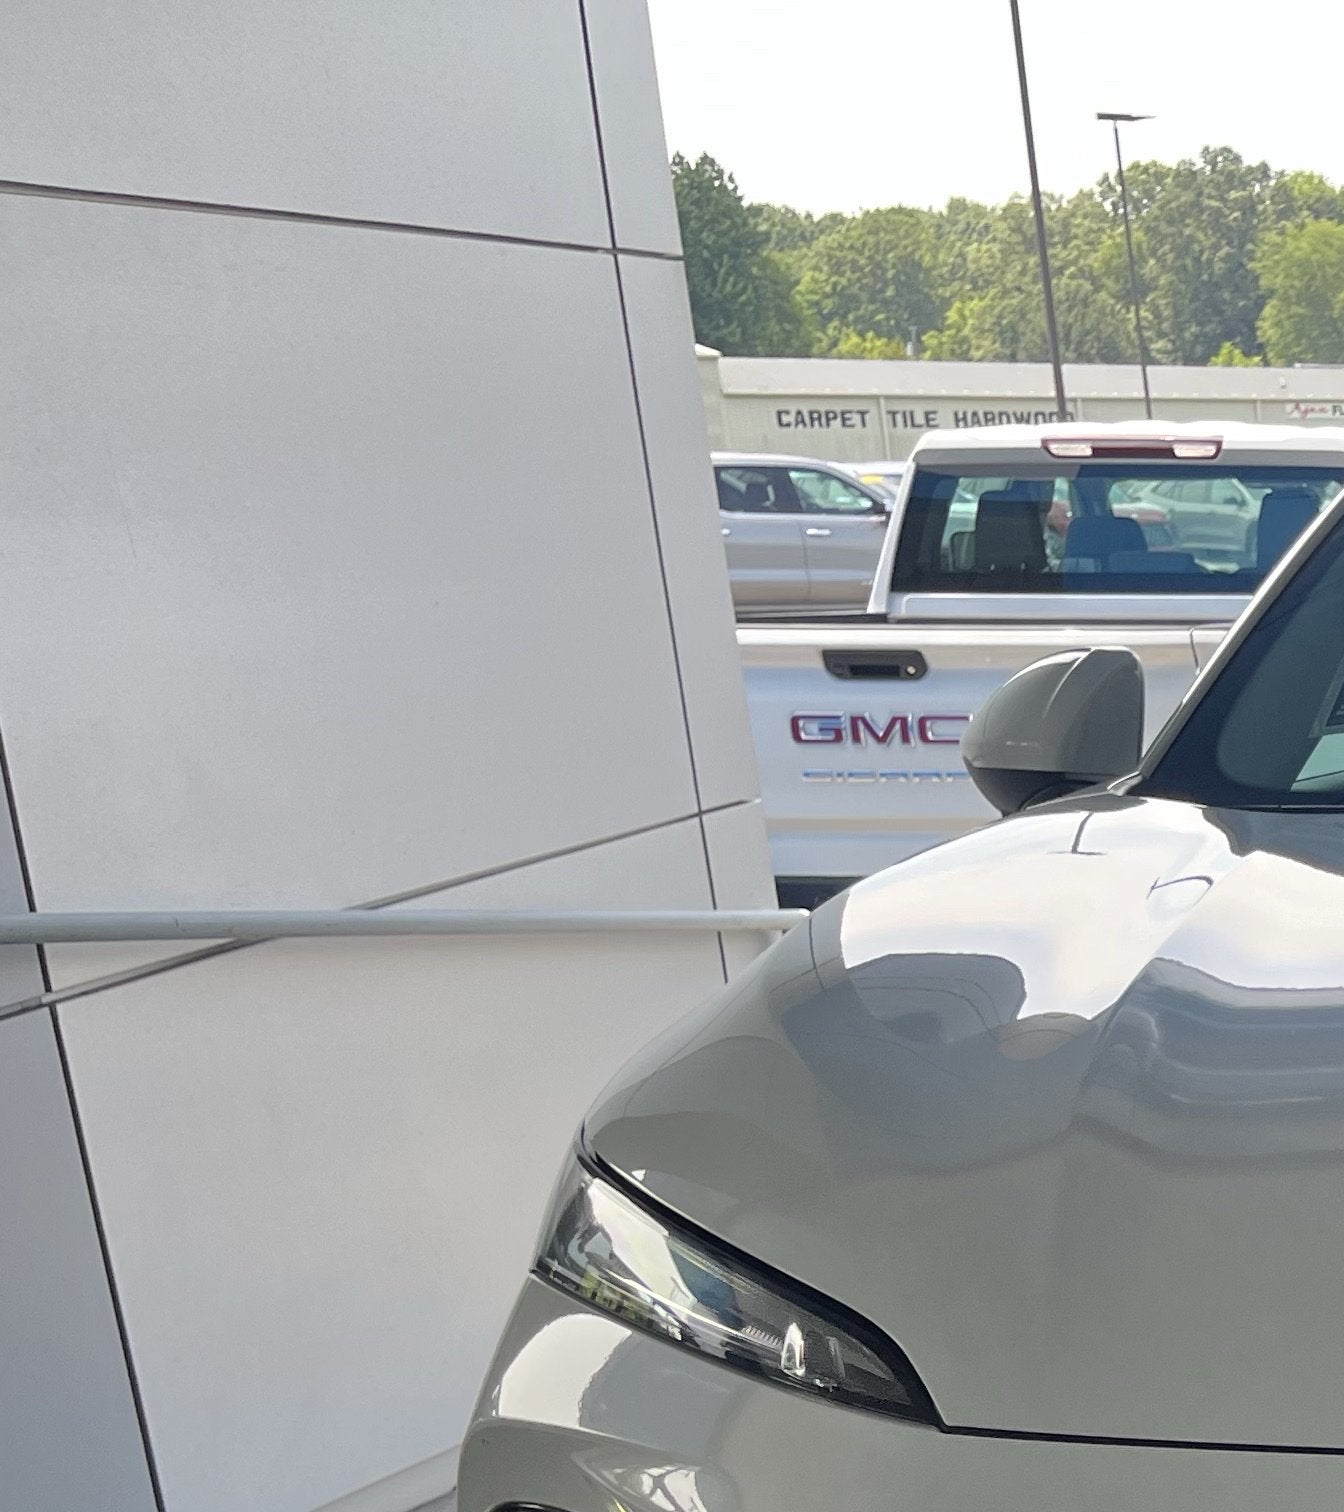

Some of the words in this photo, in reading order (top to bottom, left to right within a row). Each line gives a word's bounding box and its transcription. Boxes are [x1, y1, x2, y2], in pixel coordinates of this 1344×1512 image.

[776, 410, 870, 429] CARPET
[886, 410, 938, 429] TILE
[790, 710, 974, 748] GMC
